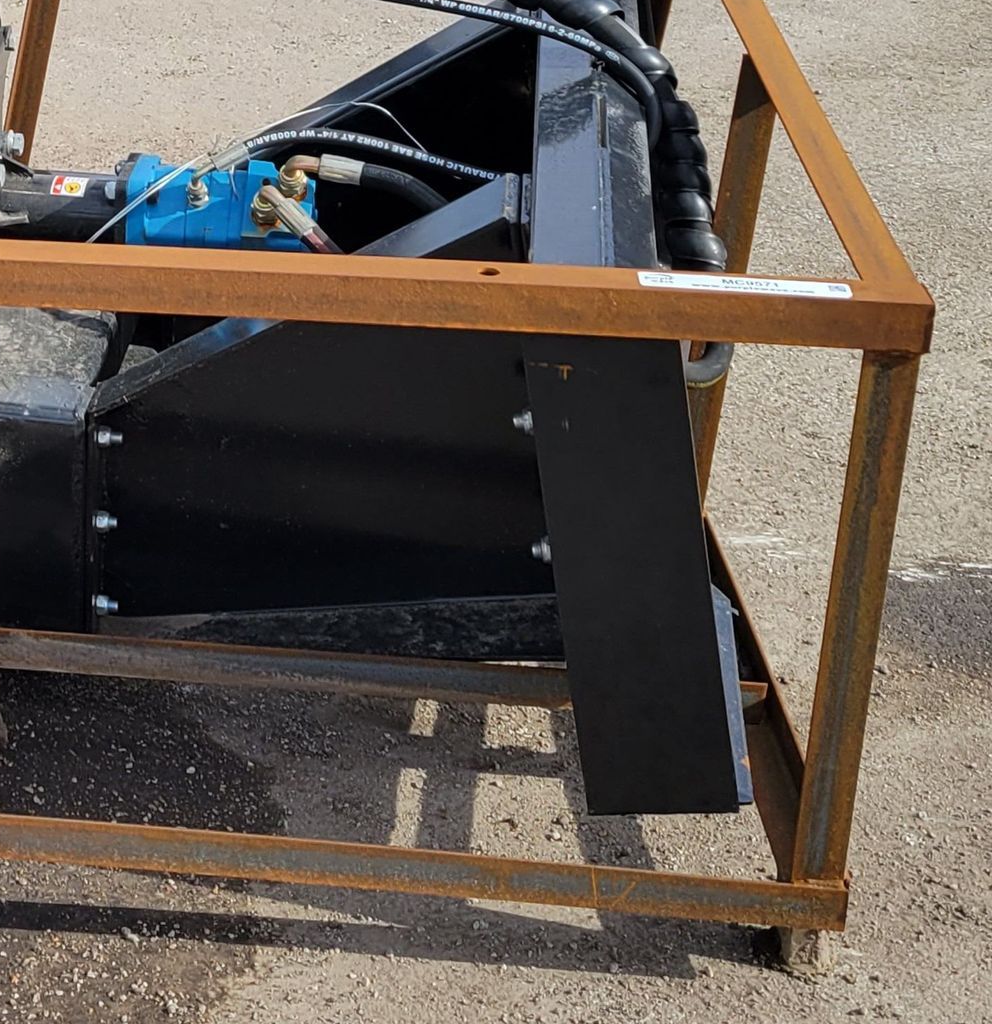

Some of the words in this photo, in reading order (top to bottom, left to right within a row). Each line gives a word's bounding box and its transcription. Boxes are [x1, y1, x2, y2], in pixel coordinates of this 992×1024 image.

[458, 3, 547, 31] 600BAR/8700PSI
[299, 129, 316, 138] WP
[340, 132, 356, 142] AT
[356, 134, 390, 149] 100R2
[391, 144, 414, 157] SAE
[414, 152, 445, 167] HOSE
